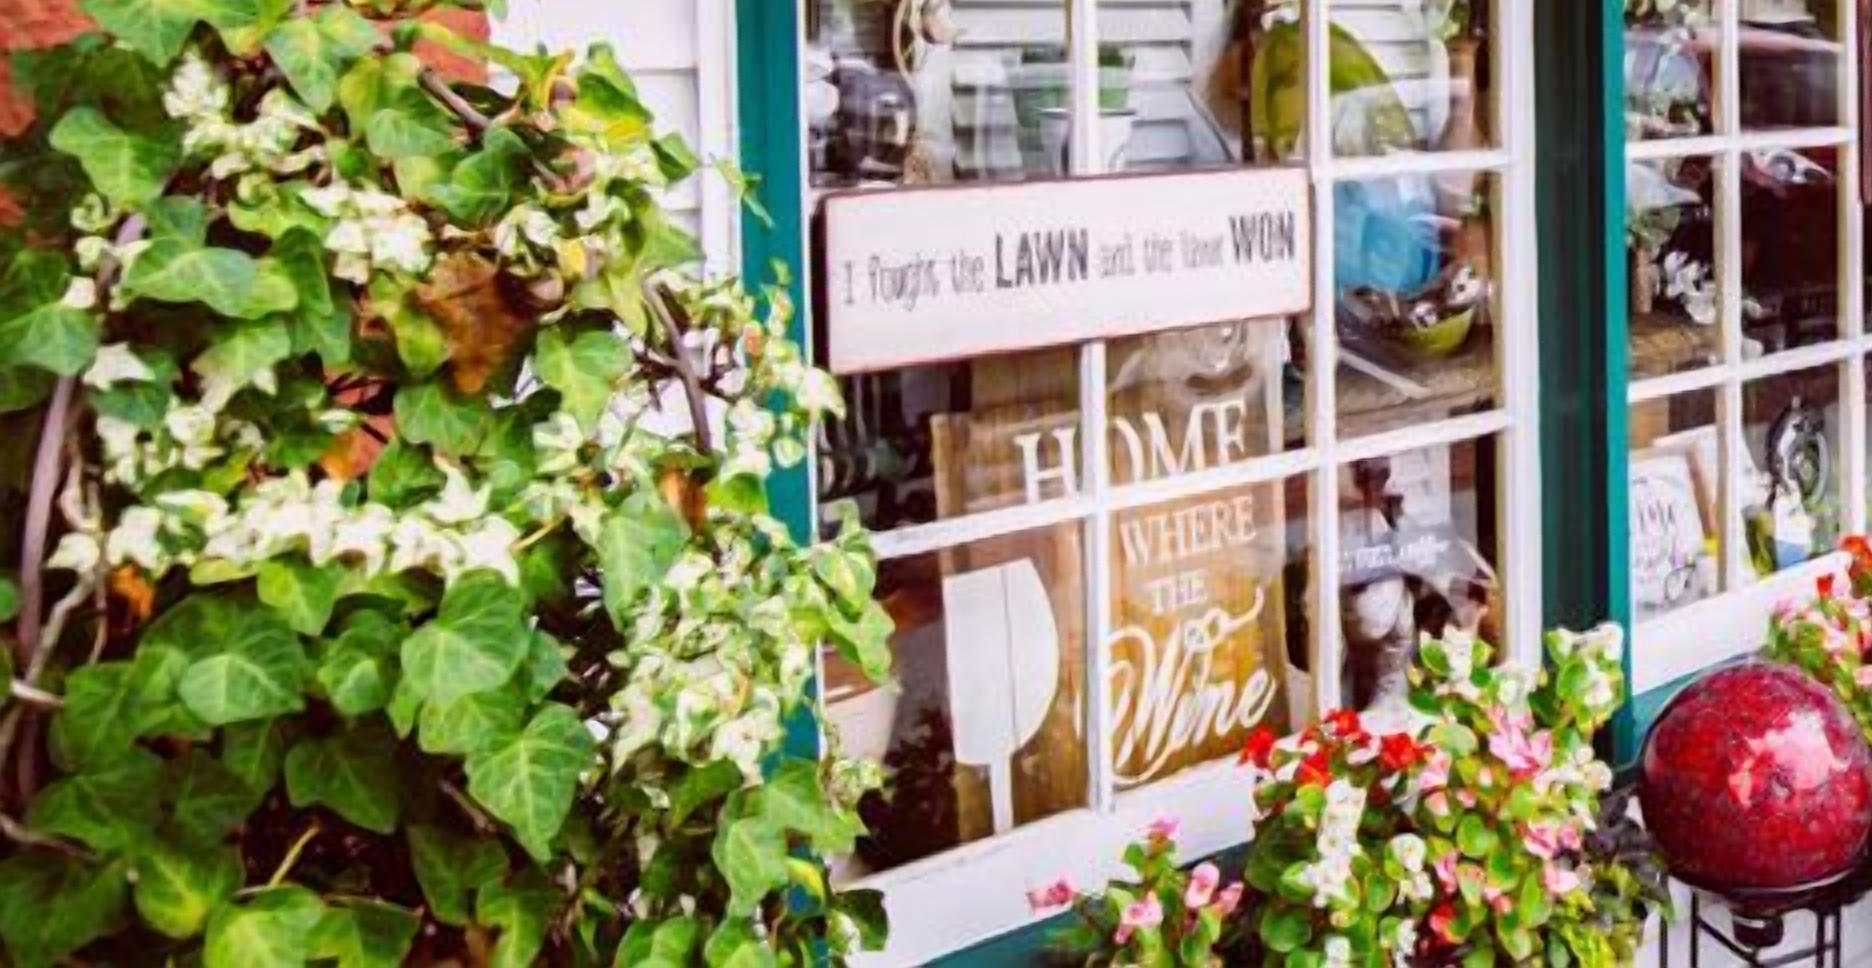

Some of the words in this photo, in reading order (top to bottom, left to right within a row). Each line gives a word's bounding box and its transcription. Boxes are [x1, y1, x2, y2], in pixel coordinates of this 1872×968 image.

[868, 254, 939, 311] fought
[951, 250, 985, 295] the
[995, 230, 1089, 288] LAWN
[1228, 210, 1294, 264] WON
[1119, 495, 1257, 567] WHERE
[1150, 568, 1208, 613] THE
[1104, 584, 1277, 784] Wine
